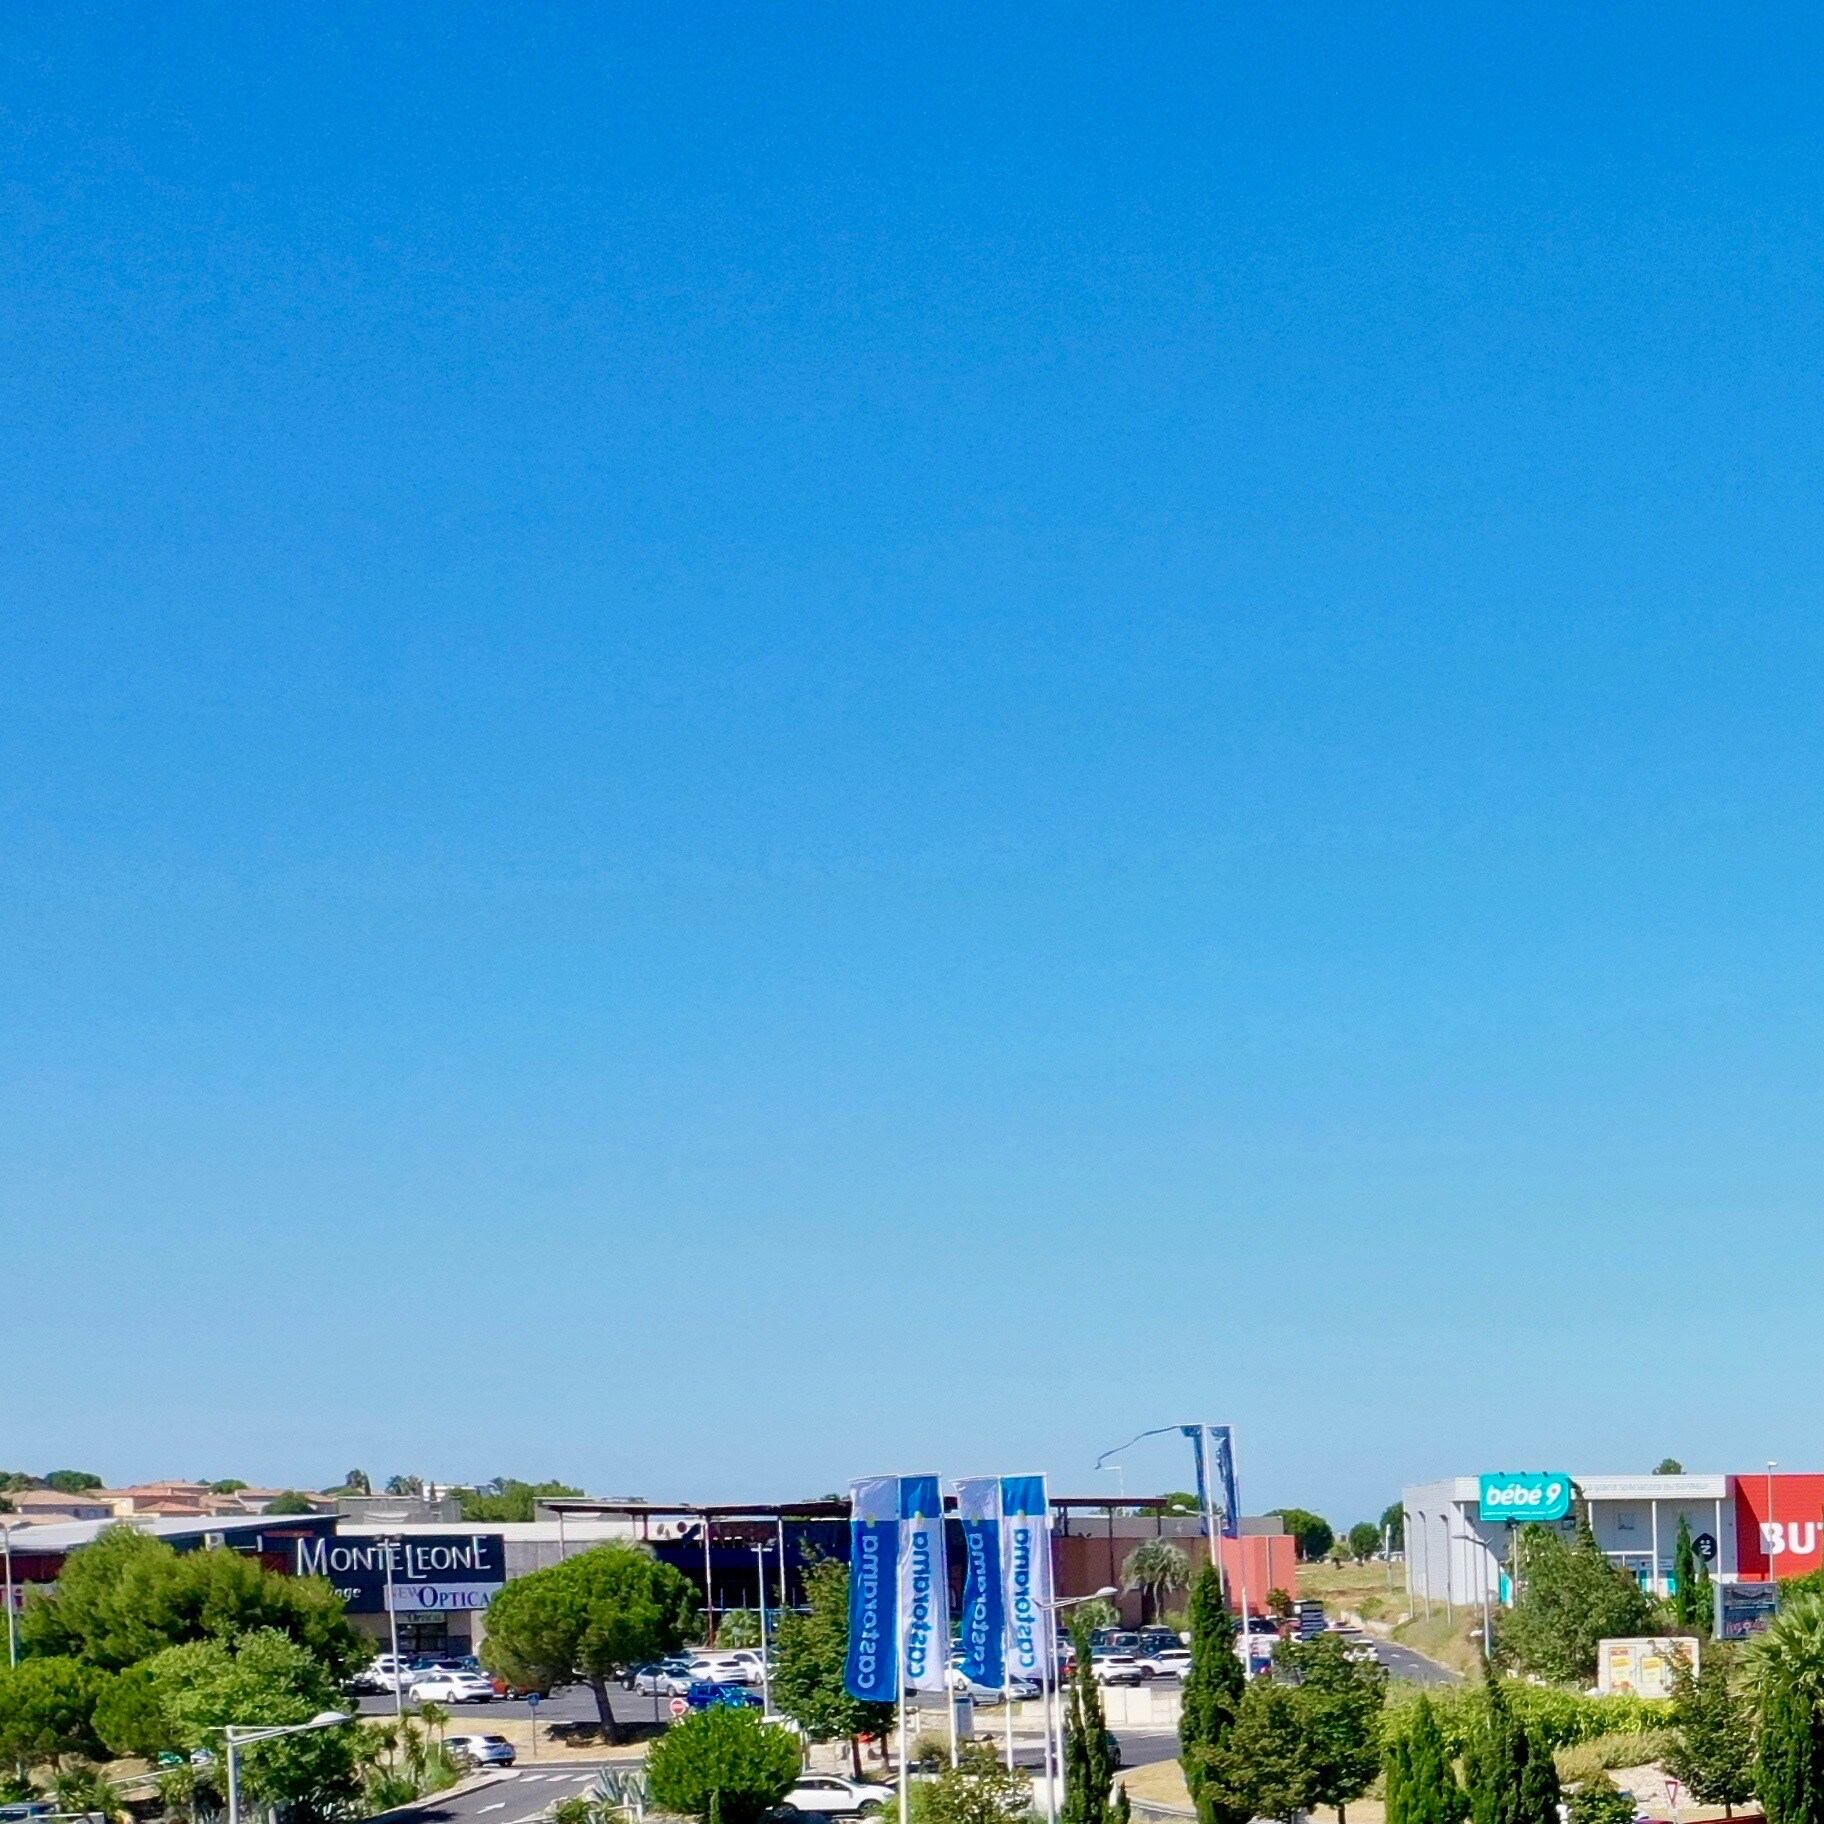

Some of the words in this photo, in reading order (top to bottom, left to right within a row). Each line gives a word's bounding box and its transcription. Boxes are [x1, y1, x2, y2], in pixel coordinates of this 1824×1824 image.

[1486, 1483, 1542, 1506] bébé
[1546, 1483, 1561, 1506] 9
[1760, 1520, 1824, 1555] BU
[297, 1536, 492, 1579] MONTELEONE
[418, 1586, 492, 1608] OPTICA
